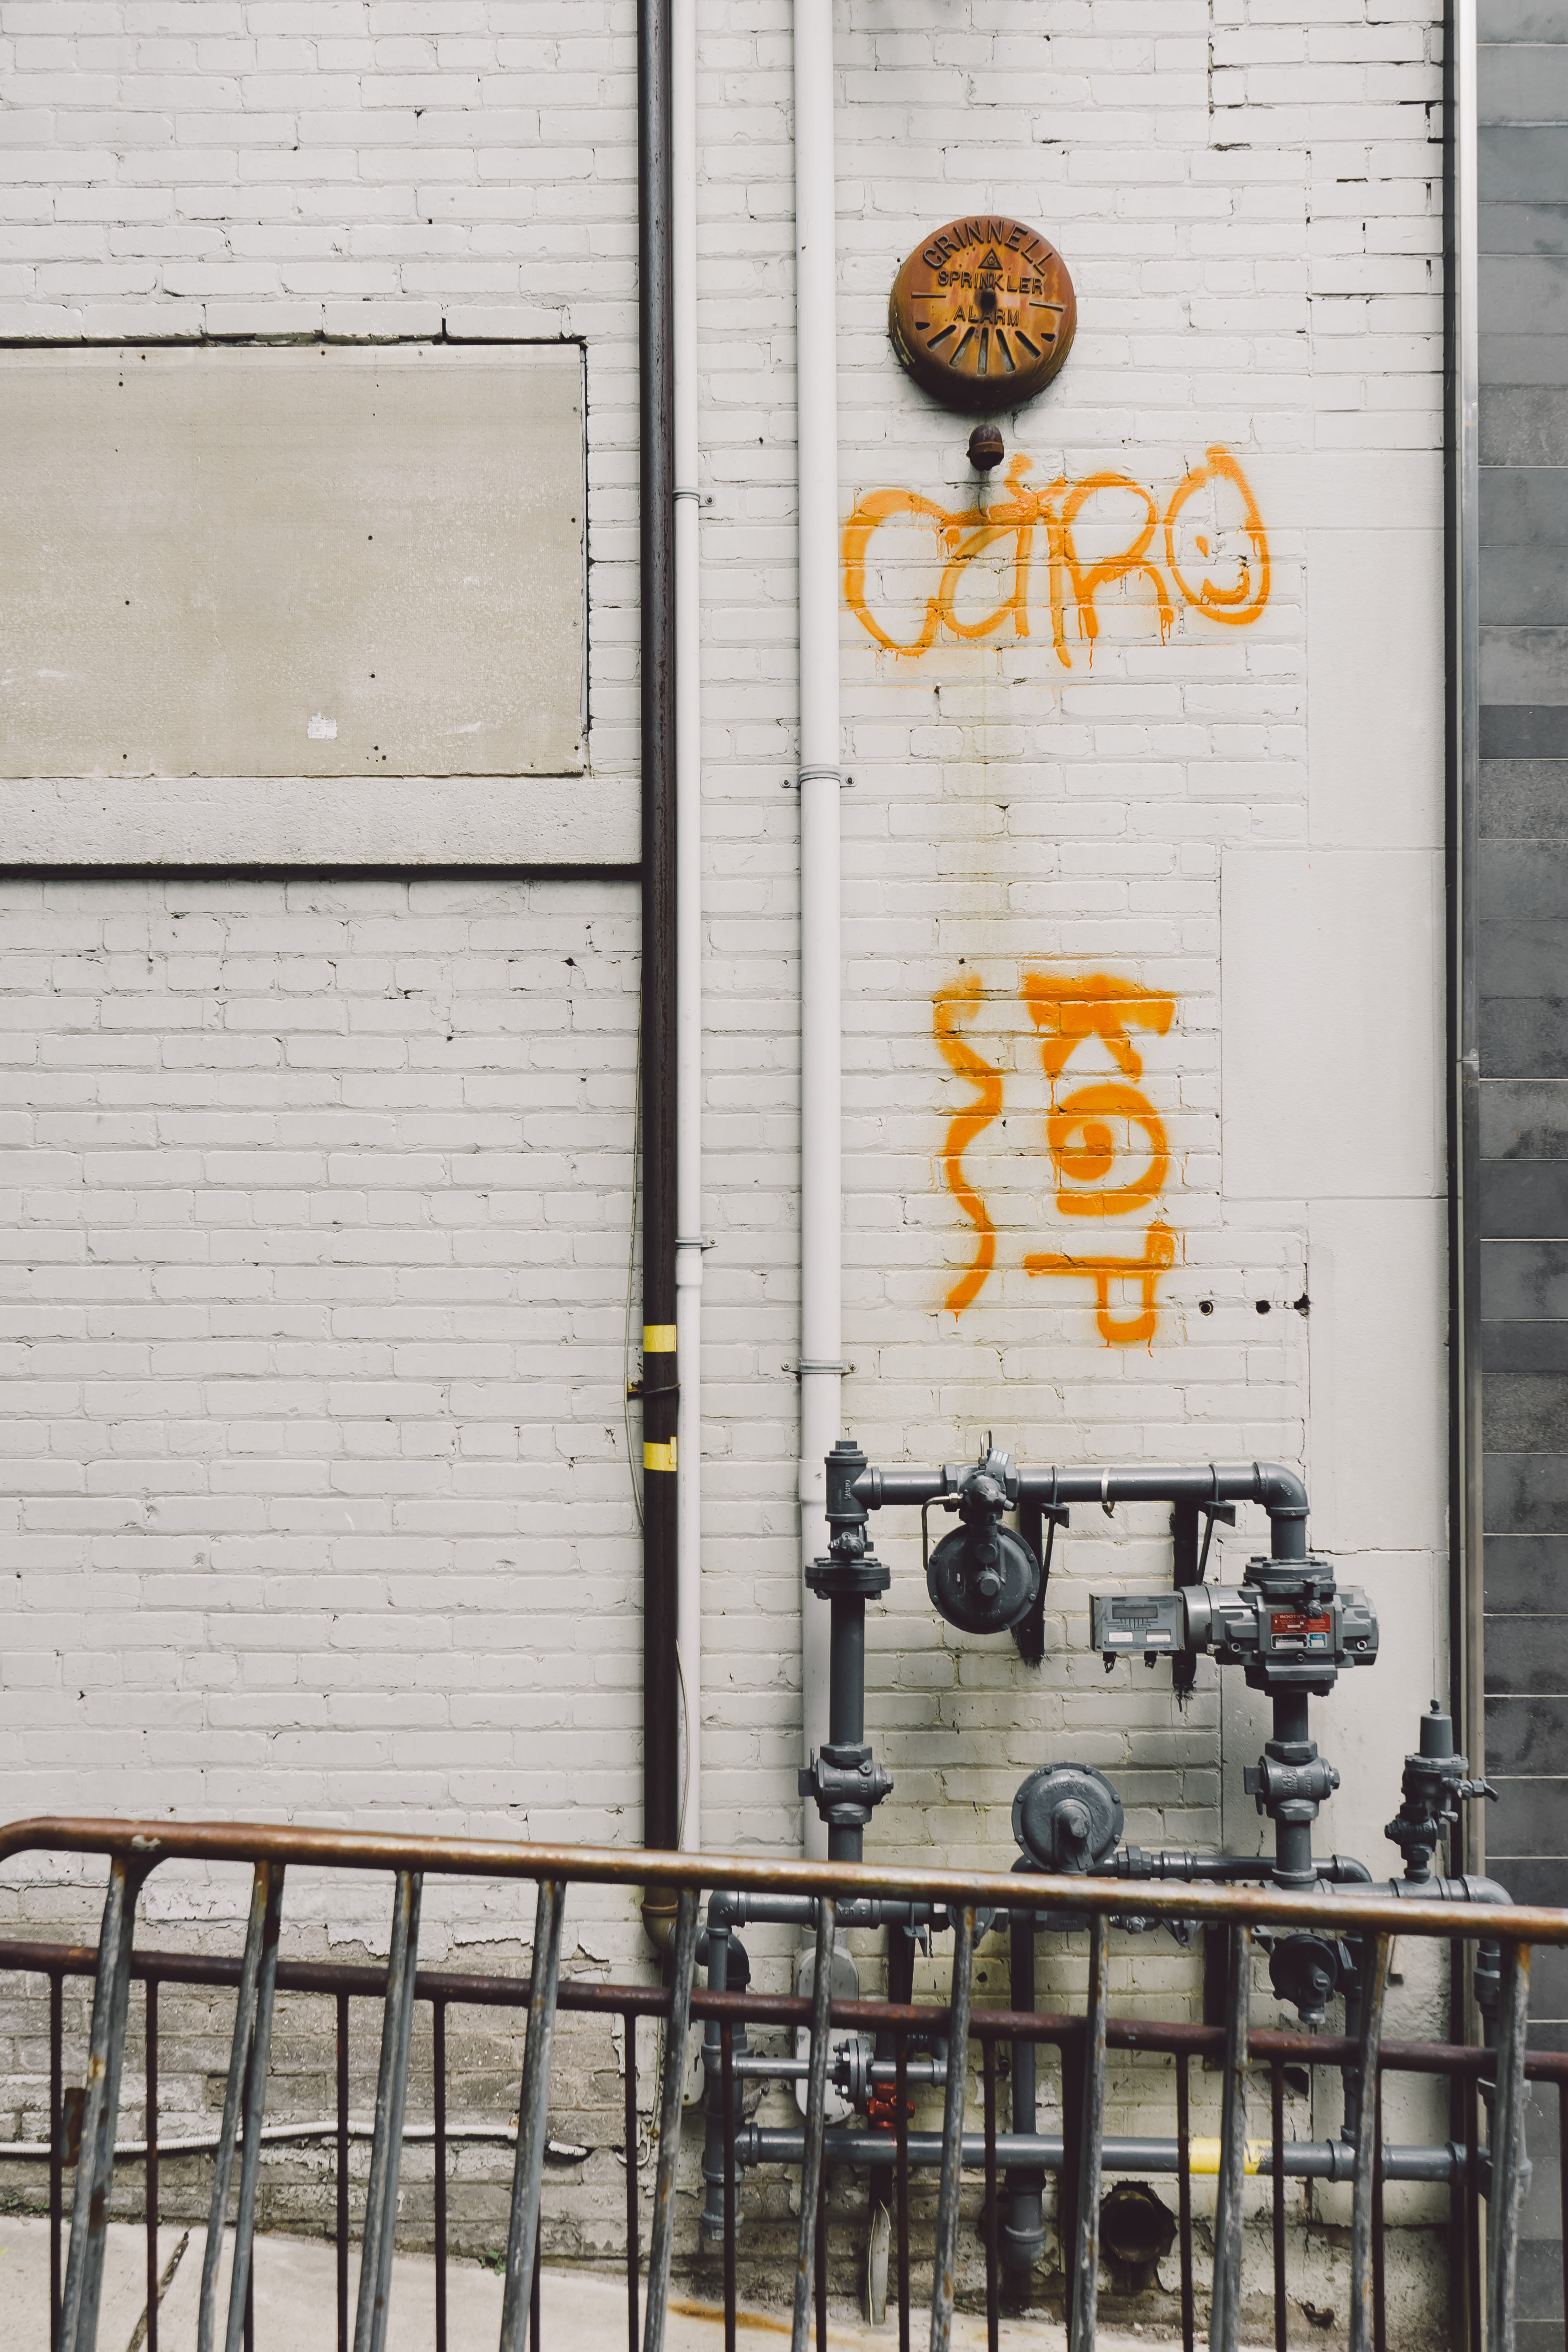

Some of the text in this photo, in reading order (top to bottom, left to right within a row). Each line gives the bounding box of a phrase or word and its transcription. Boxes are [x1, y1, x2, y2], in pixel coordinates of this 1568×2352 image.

[923, 220, 1052, 276] GRINNELL
[937, 270, 1043, 295] SPRINKLER
[953, 305, 1020, 327] ALARM
